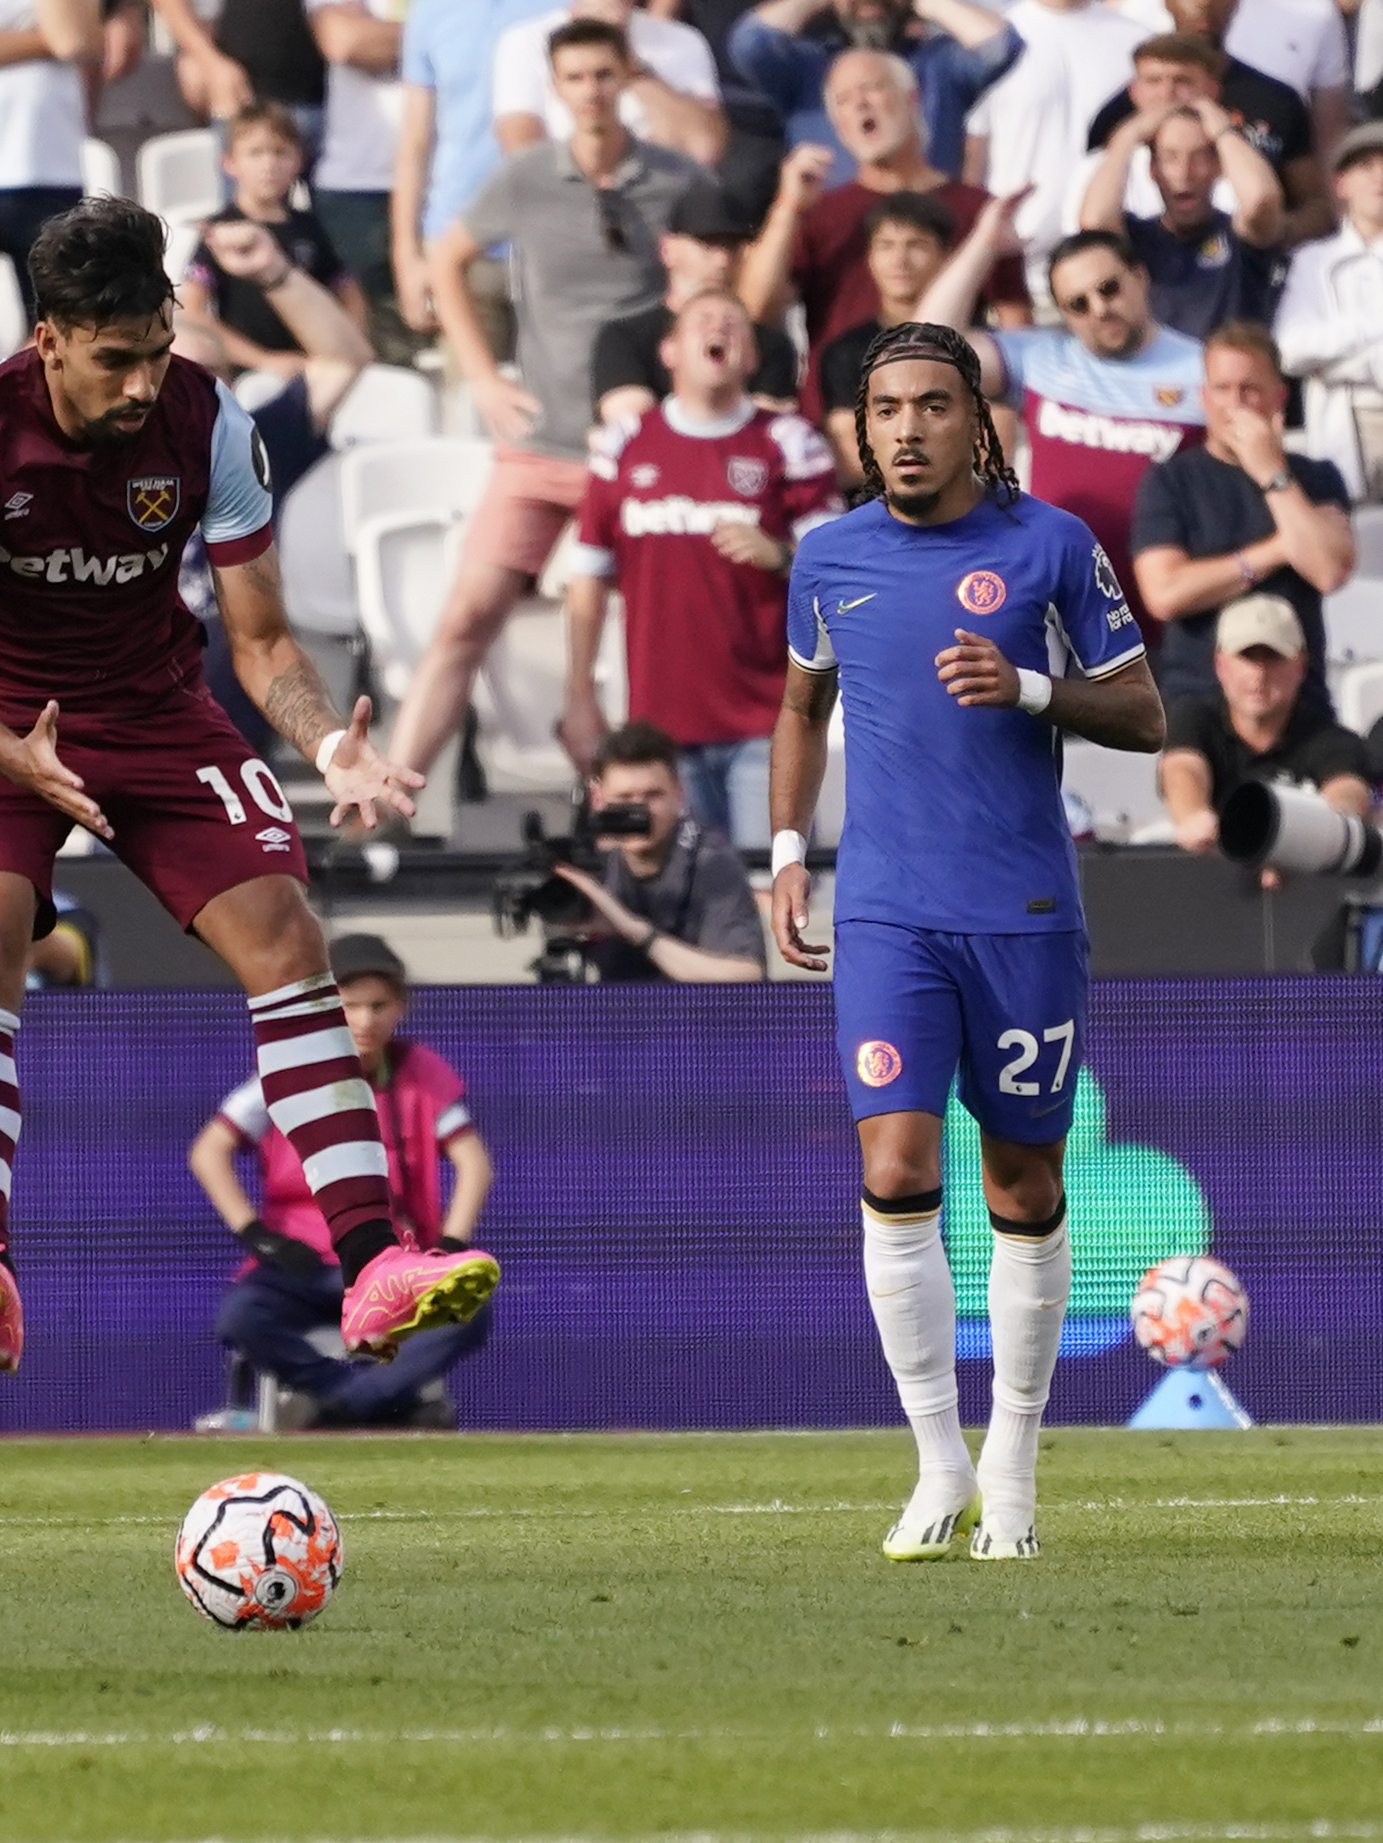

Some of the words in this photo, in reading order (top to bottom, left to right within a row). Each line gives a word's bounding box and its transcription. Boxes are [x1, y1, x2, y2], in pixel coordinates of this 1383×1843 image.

[1039, 400, 1184, 464] betway
[195, 758, 293, 825] 10
[997, 1018, 1075, 1096] 27
